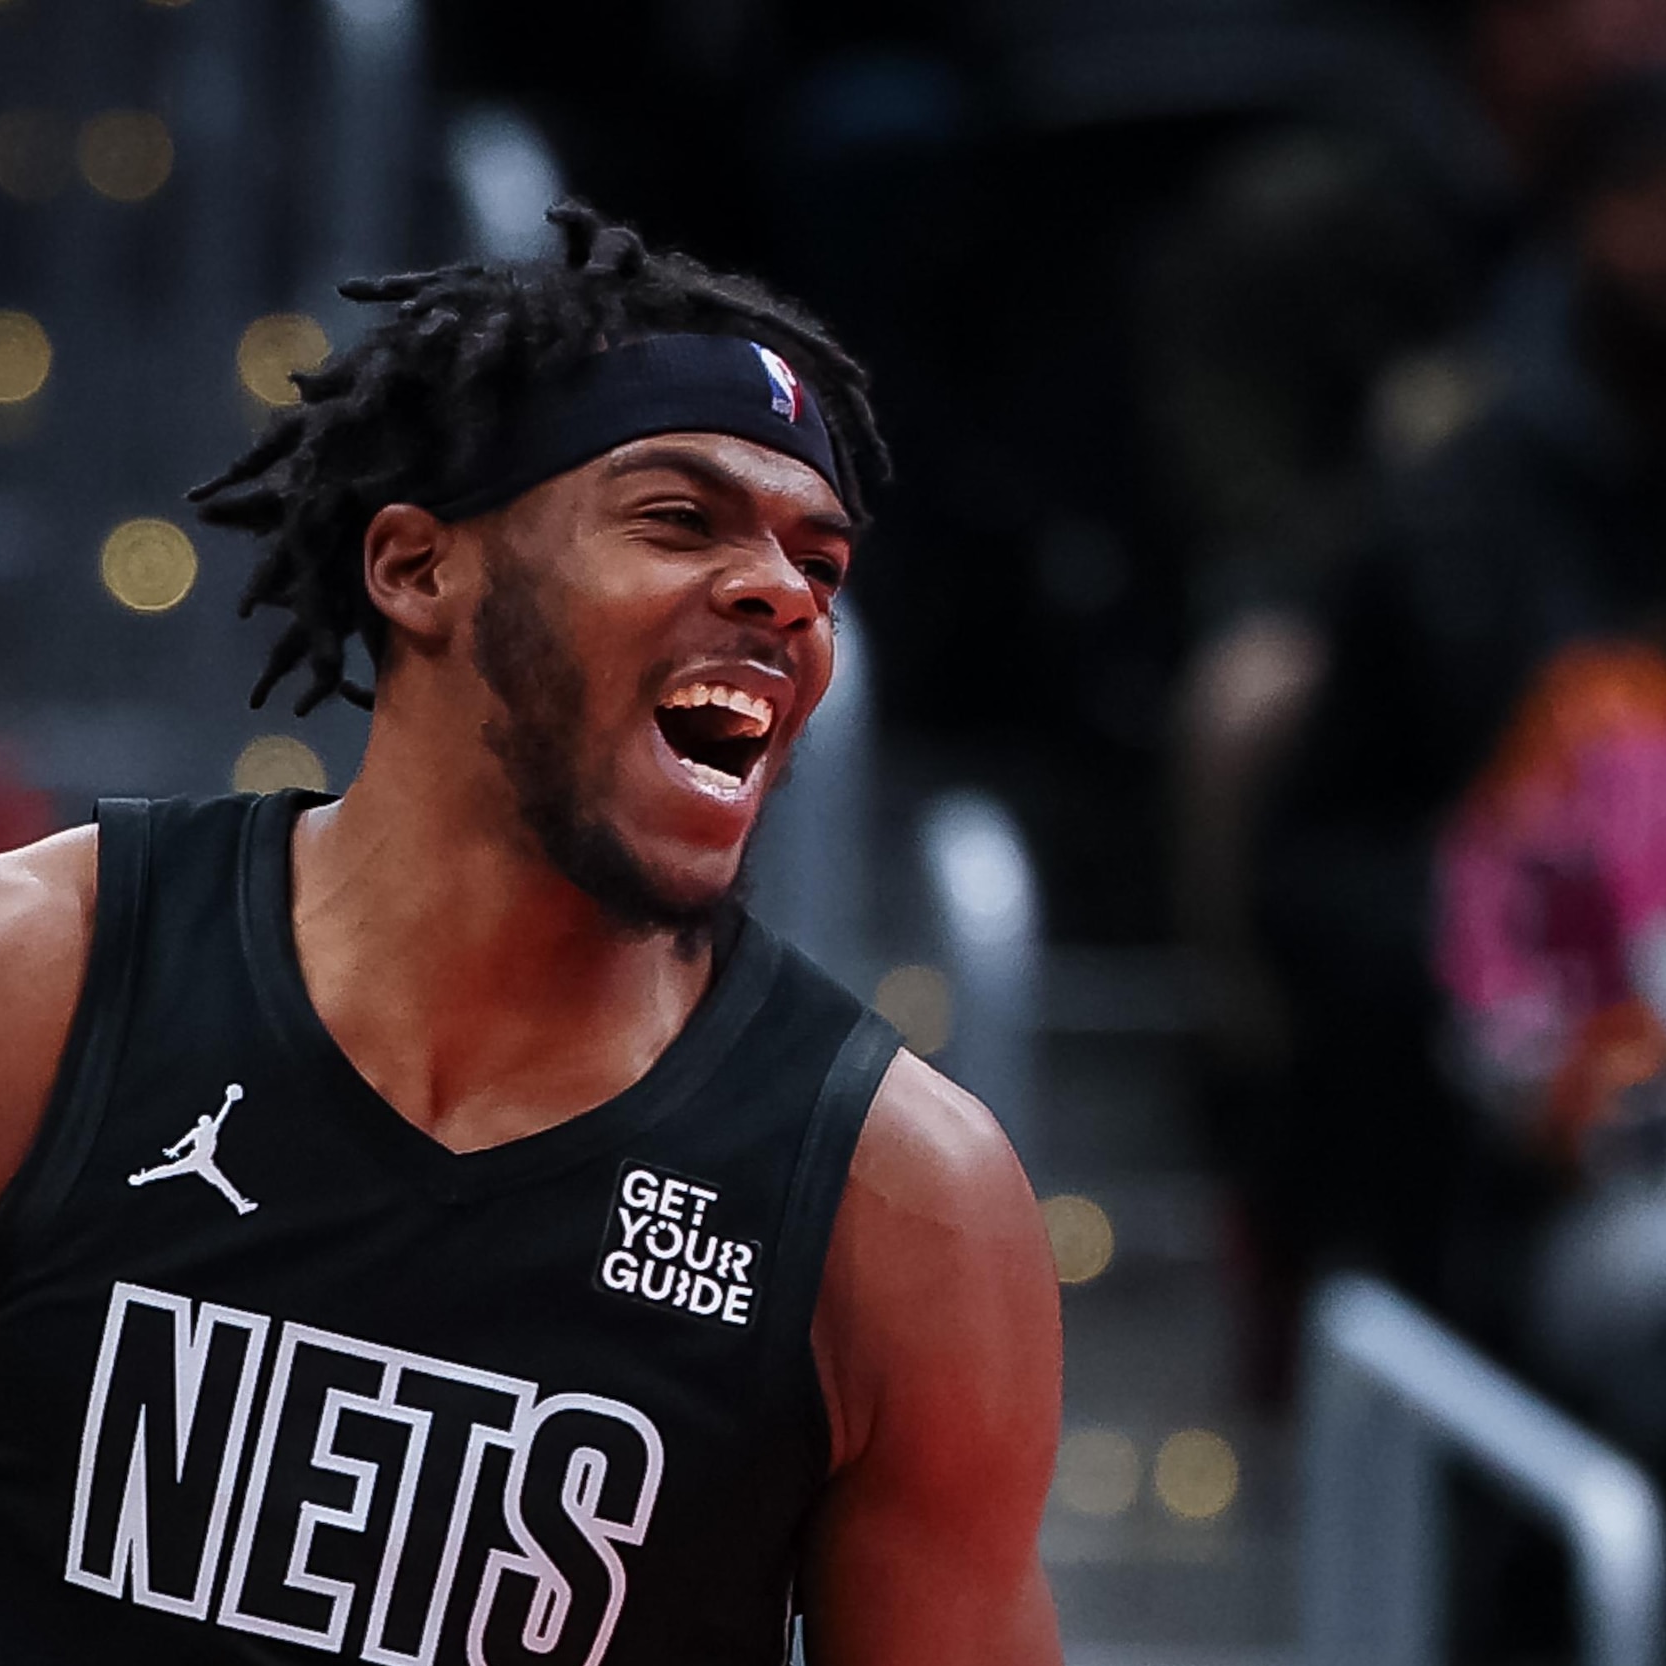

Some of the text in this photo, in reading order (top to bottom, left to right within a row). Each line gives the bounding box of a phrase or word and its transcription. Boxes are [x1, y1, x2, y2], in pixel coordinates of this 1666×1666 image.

[622, 1170, 718, 1226] GET
[618, 1207, 753, 1282] YOUR
[602, 1251, 753, 1324] GUIDE
